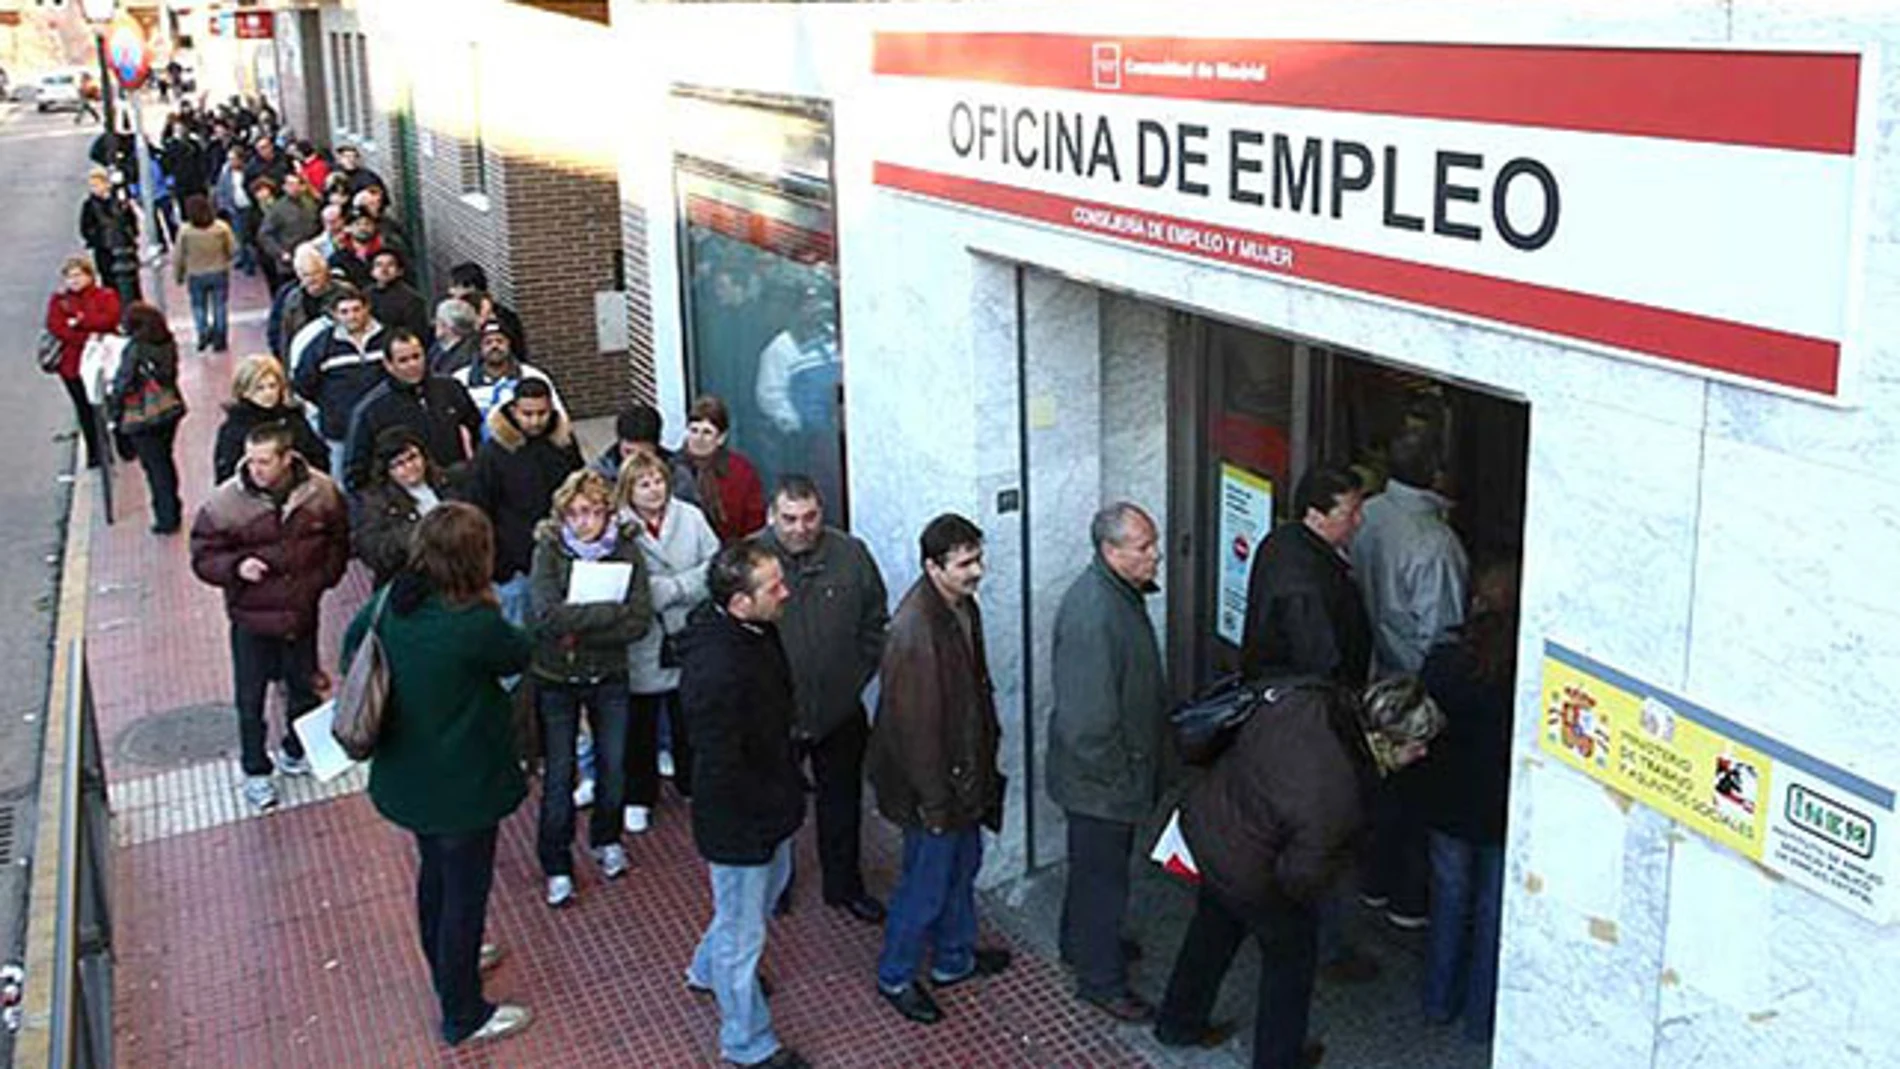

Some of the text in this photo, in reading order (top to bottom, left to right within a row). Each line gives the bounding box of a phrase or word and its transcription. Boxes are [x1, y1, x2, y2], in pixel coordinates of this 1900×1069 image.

[949, 100, 1561, 252] OFICINA DE EMPLEO
[1148, 222, 1168, 240] DE
[1167, 223, 1224, 252] EMPLEO
[1224, 238, 1238, 255] Y
[1238, 240, 1294, 267] MUJER
